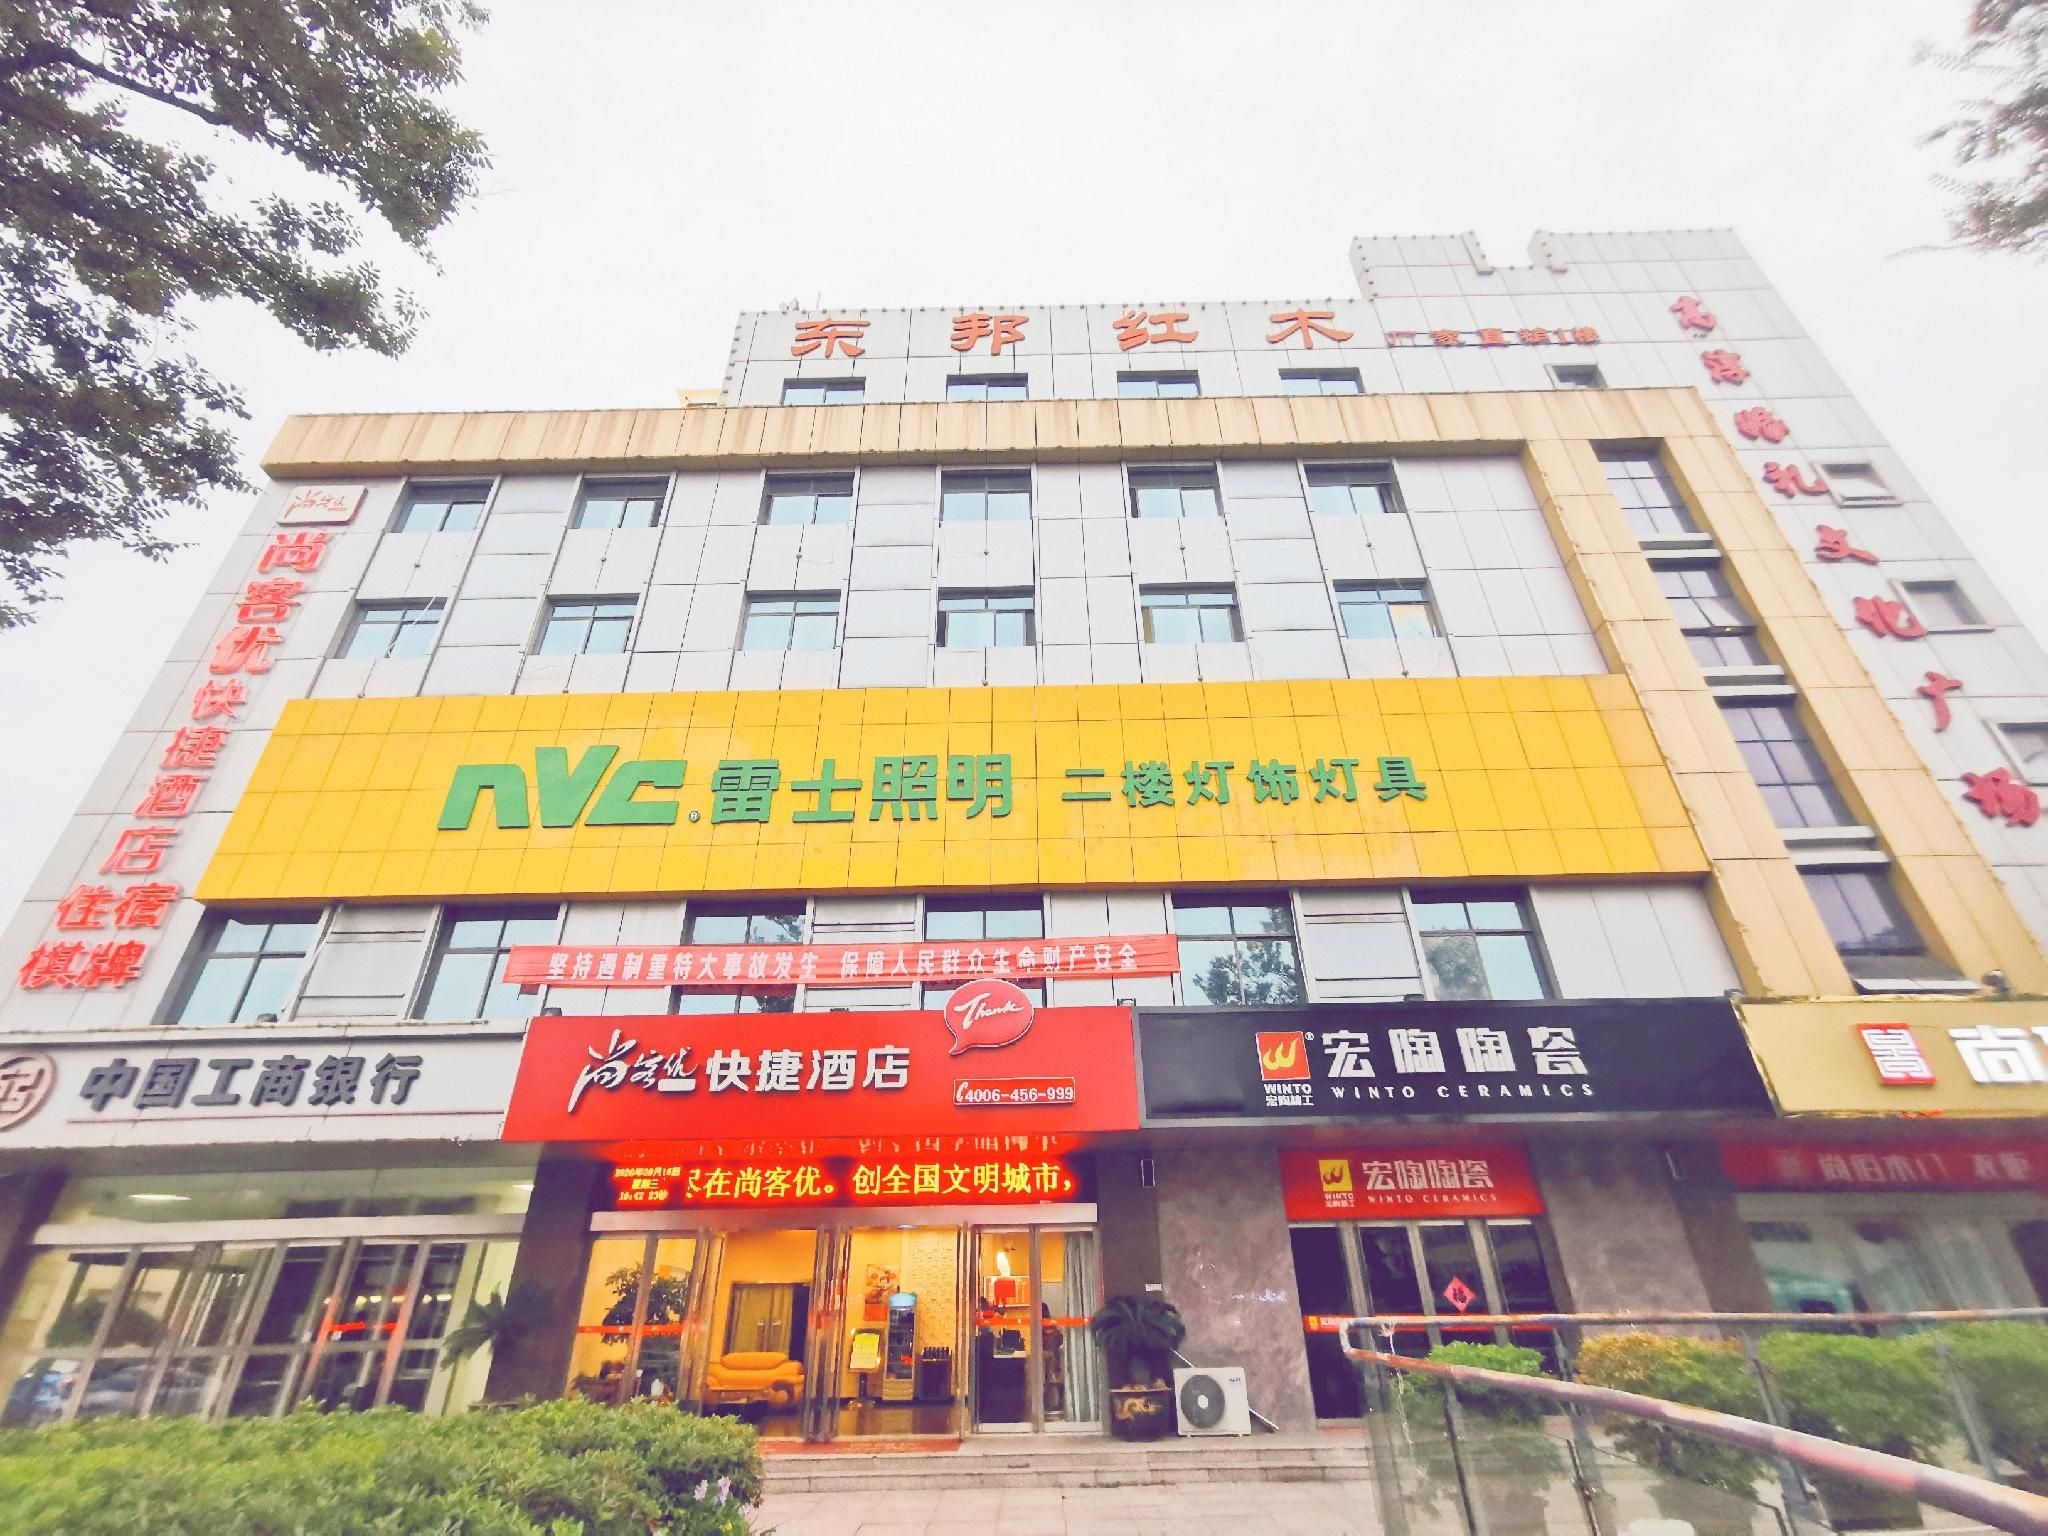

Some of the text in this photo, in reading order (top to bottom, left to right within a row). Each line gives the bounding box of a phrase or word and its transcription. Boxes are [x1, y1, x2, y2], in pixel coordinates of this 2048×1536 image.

[791, 310, 1353, 358] 东邦红木
[98, 531, 333, 876] 尚客优快捷酒店
[711, 753, 1427, 824] 雷士照明 二楼灯饰灯具
[55, 882, 183, 932] 住宿
[16, 938, 152, 992] 棋牌
[546, 943, 1139, 981] 坚持遏制重特大事故发生 保障人民群众生命财产安全
[705, 1045, 910, 1092] 快捷酒店
[1321, 1026, 1589, 1078] 宏陶陶瓷
[1948, 1024, 2048, 1084] 尚
[79, 1054, 424, 1112] 中国工商银行
[965, 1086, 1074, 1103] 4006-456-999
[1263, 1083, 1312, 1095] WINTO
[1331, 1083, 1593, 1099] WINTO CERAMICS
[1362, 1160, 1494, 1190] 宏陶陶瓷
[1367, 1195, 1413, 1204] WINTO
